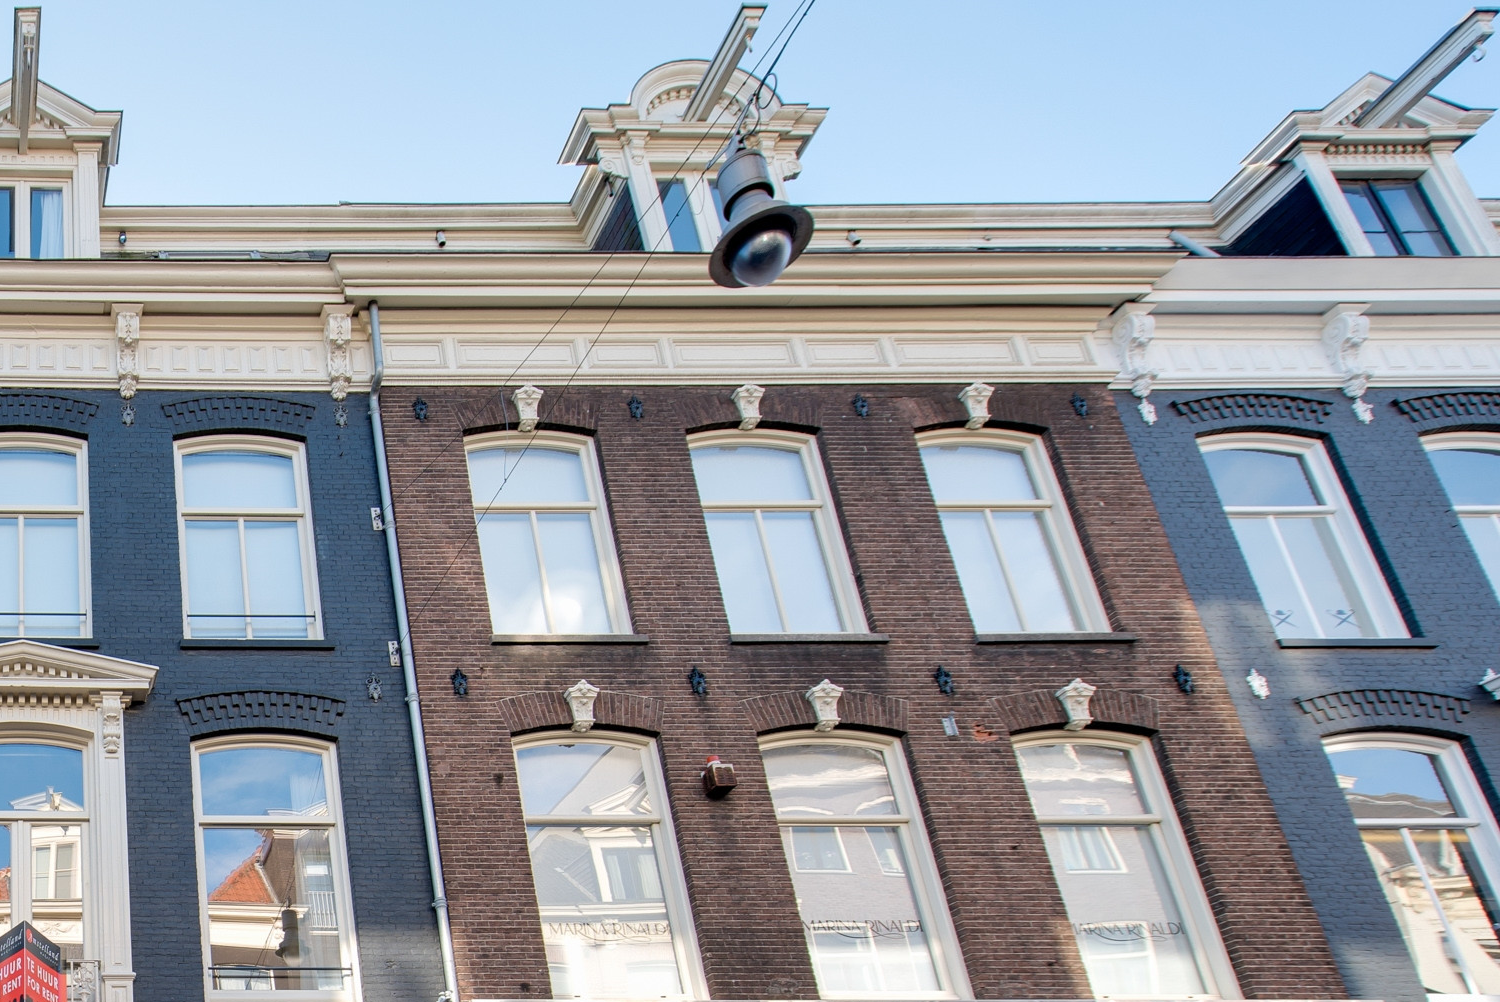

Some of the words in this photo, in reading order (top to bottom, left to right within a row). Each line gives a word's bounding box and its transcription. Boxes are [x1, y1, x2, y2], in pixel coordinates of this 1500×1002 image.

[548, 922, 609, 938] MARINA
[802, 920, 861, 935] MARINA
[27, 956, 34, 973] TE
[37, 965, 59, 990] HUUR
[2, 975, 22, 996] RENT
[27, 975, 40, 994] FOR
